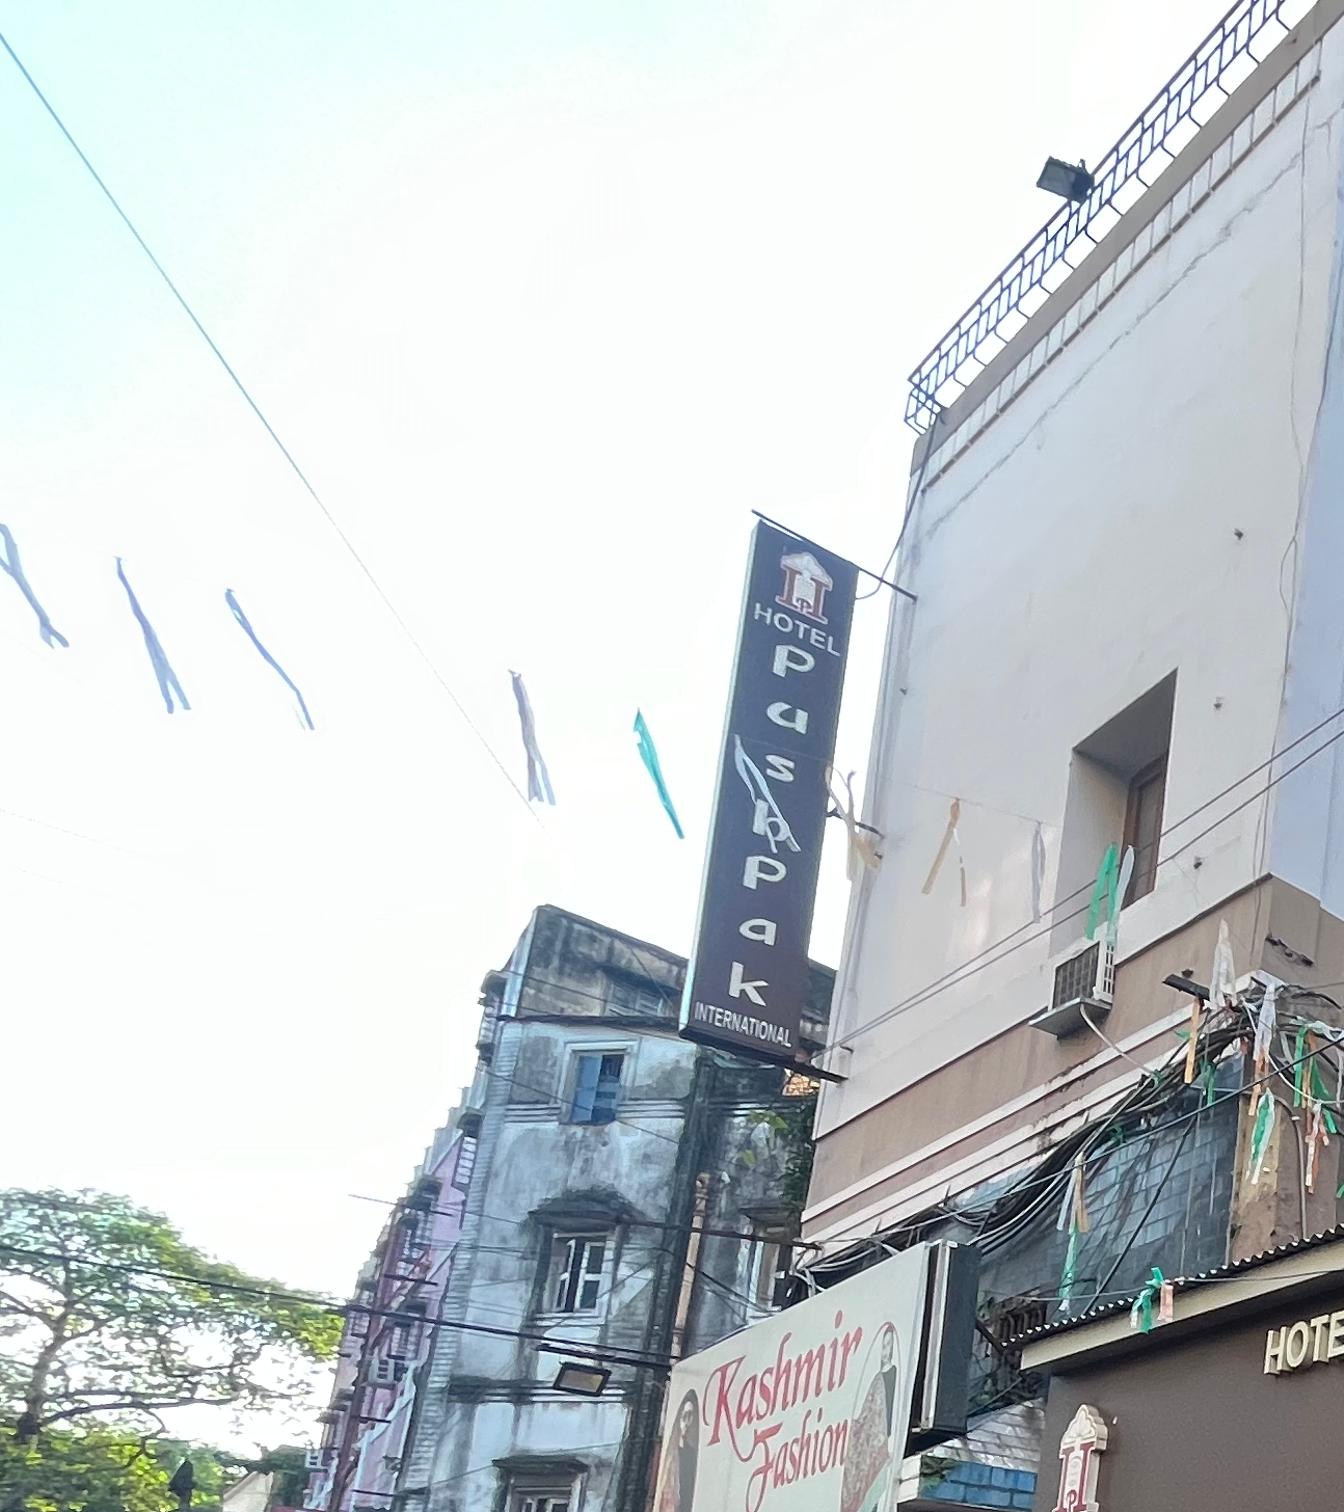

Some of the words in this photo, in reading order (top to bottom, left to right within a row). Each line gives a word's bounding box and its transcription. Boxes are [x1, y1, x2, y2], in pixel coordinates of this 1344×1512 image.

[754, 603, 840, 657] HOTEL
[694, 1001, 792, 1047] INTERNATIONAL
[702, 1310, 863, 1460] Kashmir
